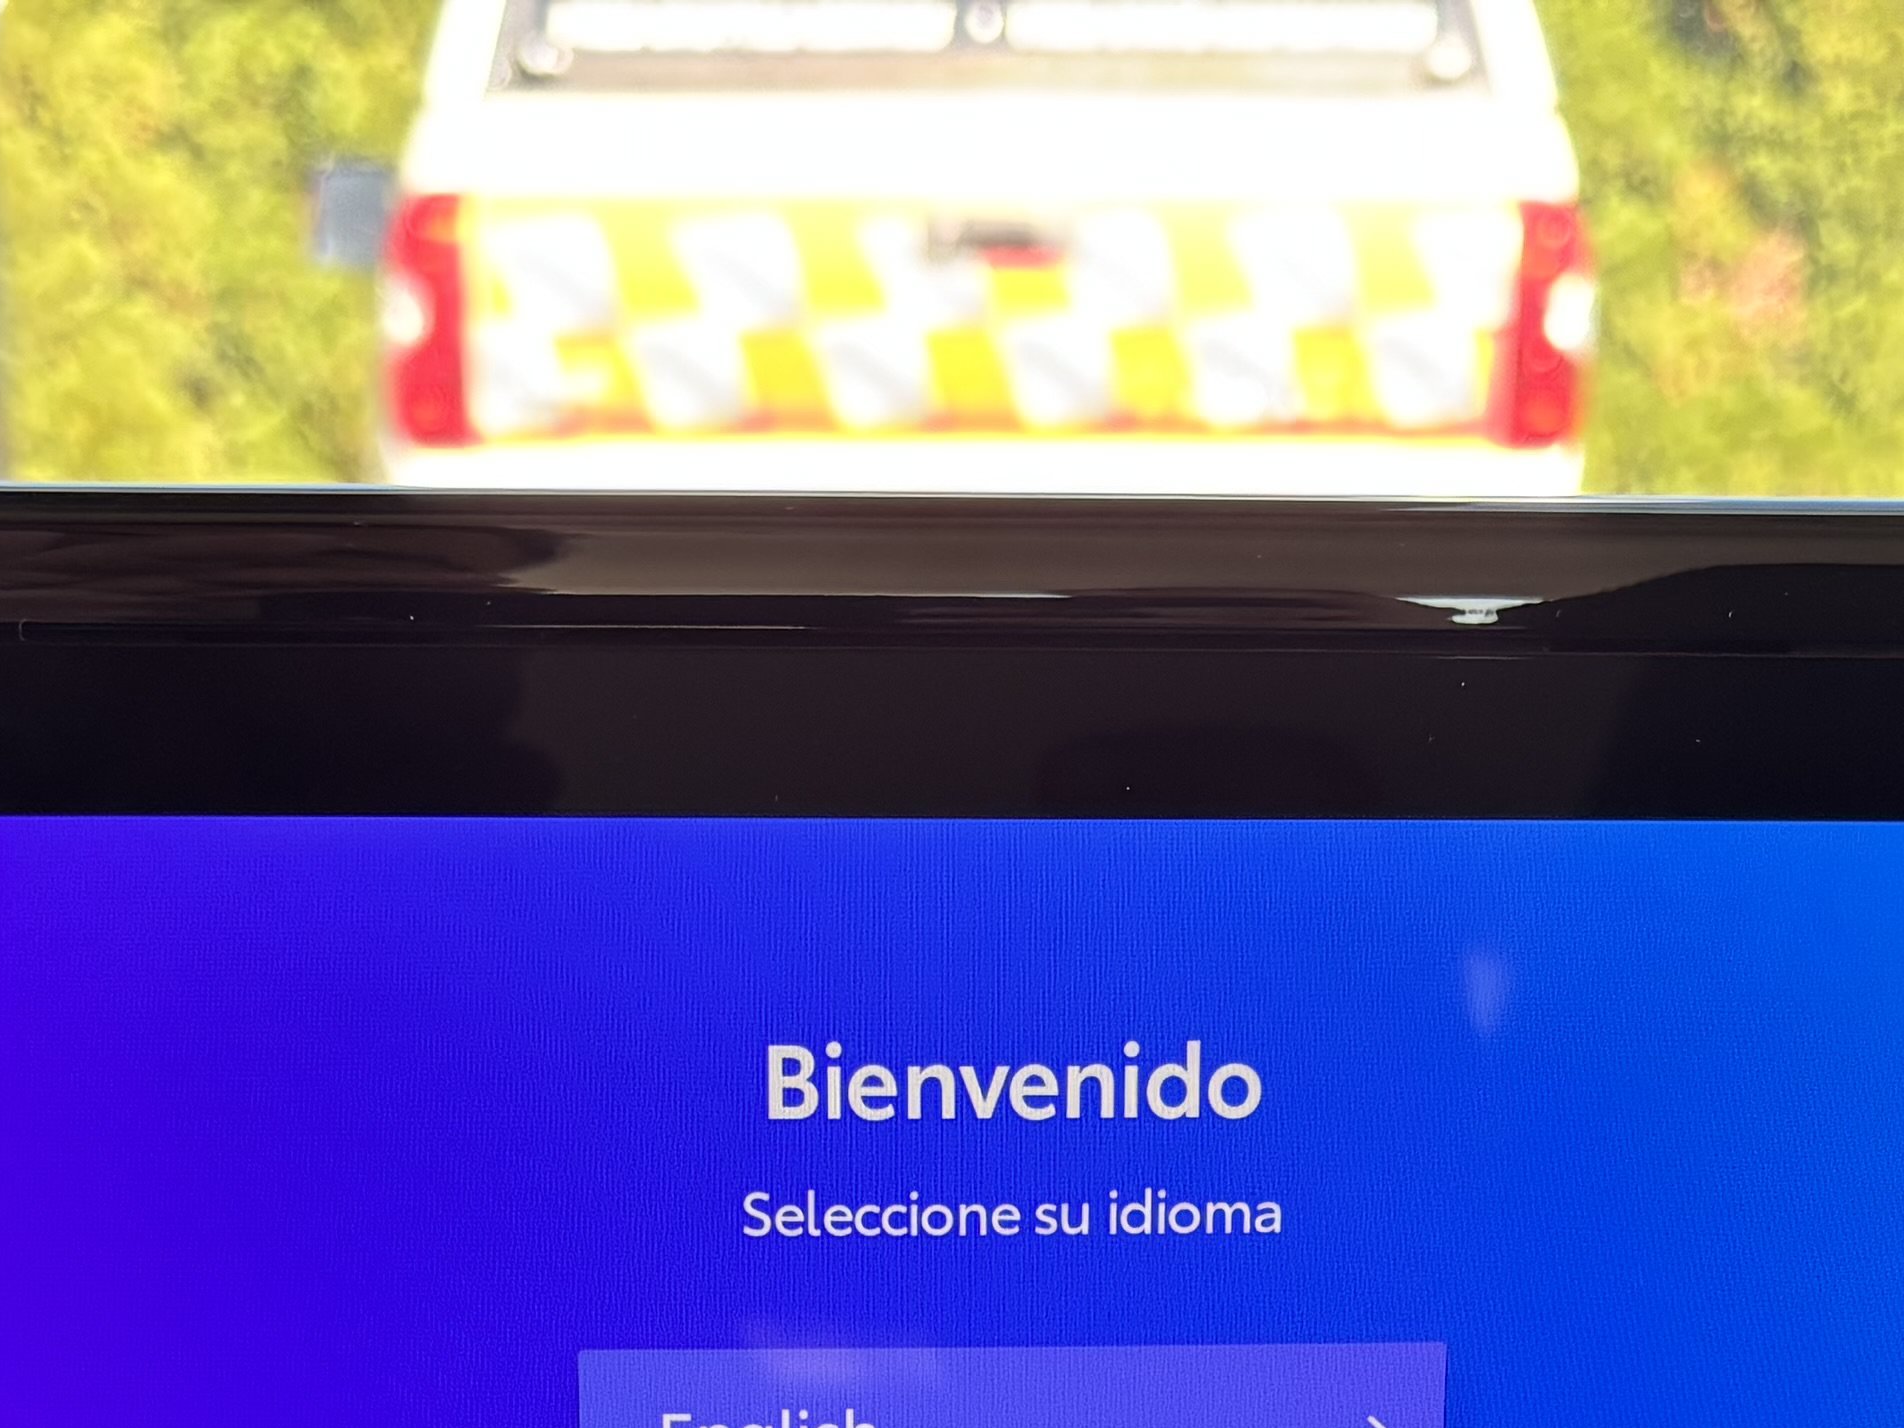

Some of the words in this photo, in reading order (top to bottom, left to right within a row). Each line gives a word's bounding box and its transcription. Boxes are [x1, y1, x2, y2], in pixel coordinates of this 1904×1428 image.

[765, 1040, 1263, 1123] Bienvenido
[741, 1190, 1021, 1238] Seleccione
[1035, 1198, 1091, 1237] su
[1106, 1187, 1284, 1236] idioma
